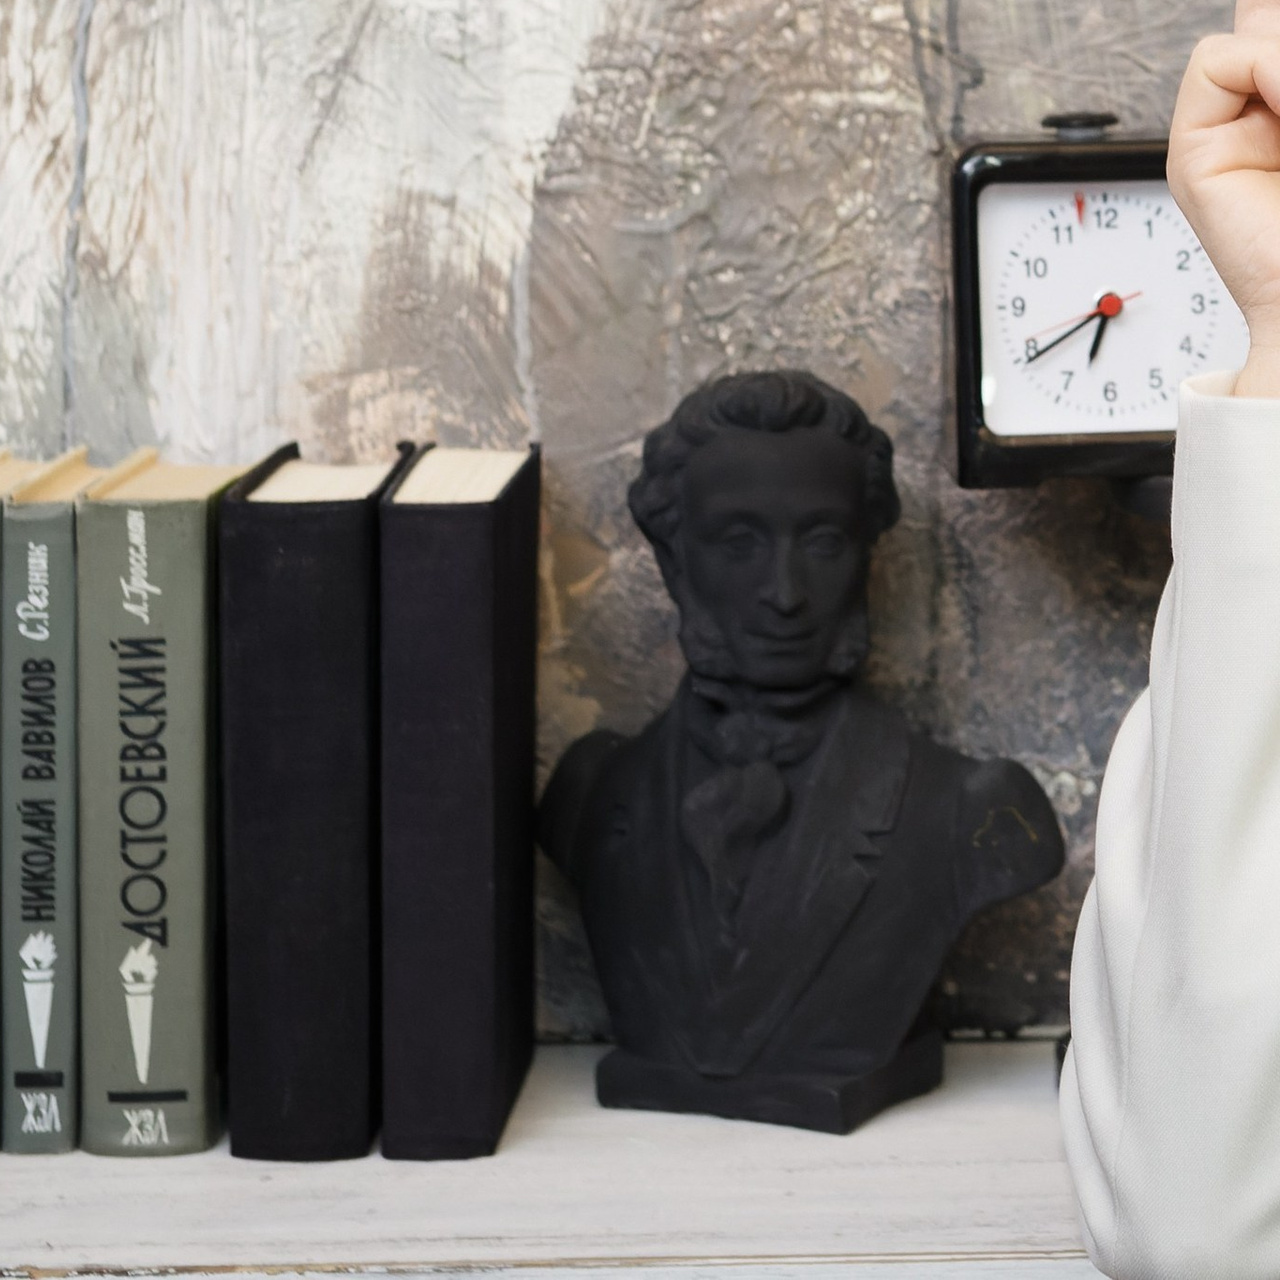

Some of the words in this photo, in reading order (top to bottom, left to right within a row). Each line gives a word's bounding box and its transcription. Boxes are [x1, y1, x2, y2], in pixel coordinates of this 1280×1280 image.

[1094, 208, 1120, 230] 12
[1143, 219, 1153, 239] 1
[1053, 225, 1074, 244] 11
[1023, 257, 1048, 279] 10
[1176, 250, 1191, 271] 2
[1011, 296, 1026, 318] 9
[1190, 294, 1206, 315] 3
[1024, 338, 1039, 360] 8
[1178, 335, 1194, 355] 4
[1060, 371, 1074, 391] 7
[1148, 369, 1163, 390] 5
[1103, 381, 1118, 403] 6
[20, 657, 56, 781] ВАВИЛОВ
[108, 636, 168, 948] ДОСТОЕВСКИЙ
[16, 798, 56, 922] НИКОЛАЙ
